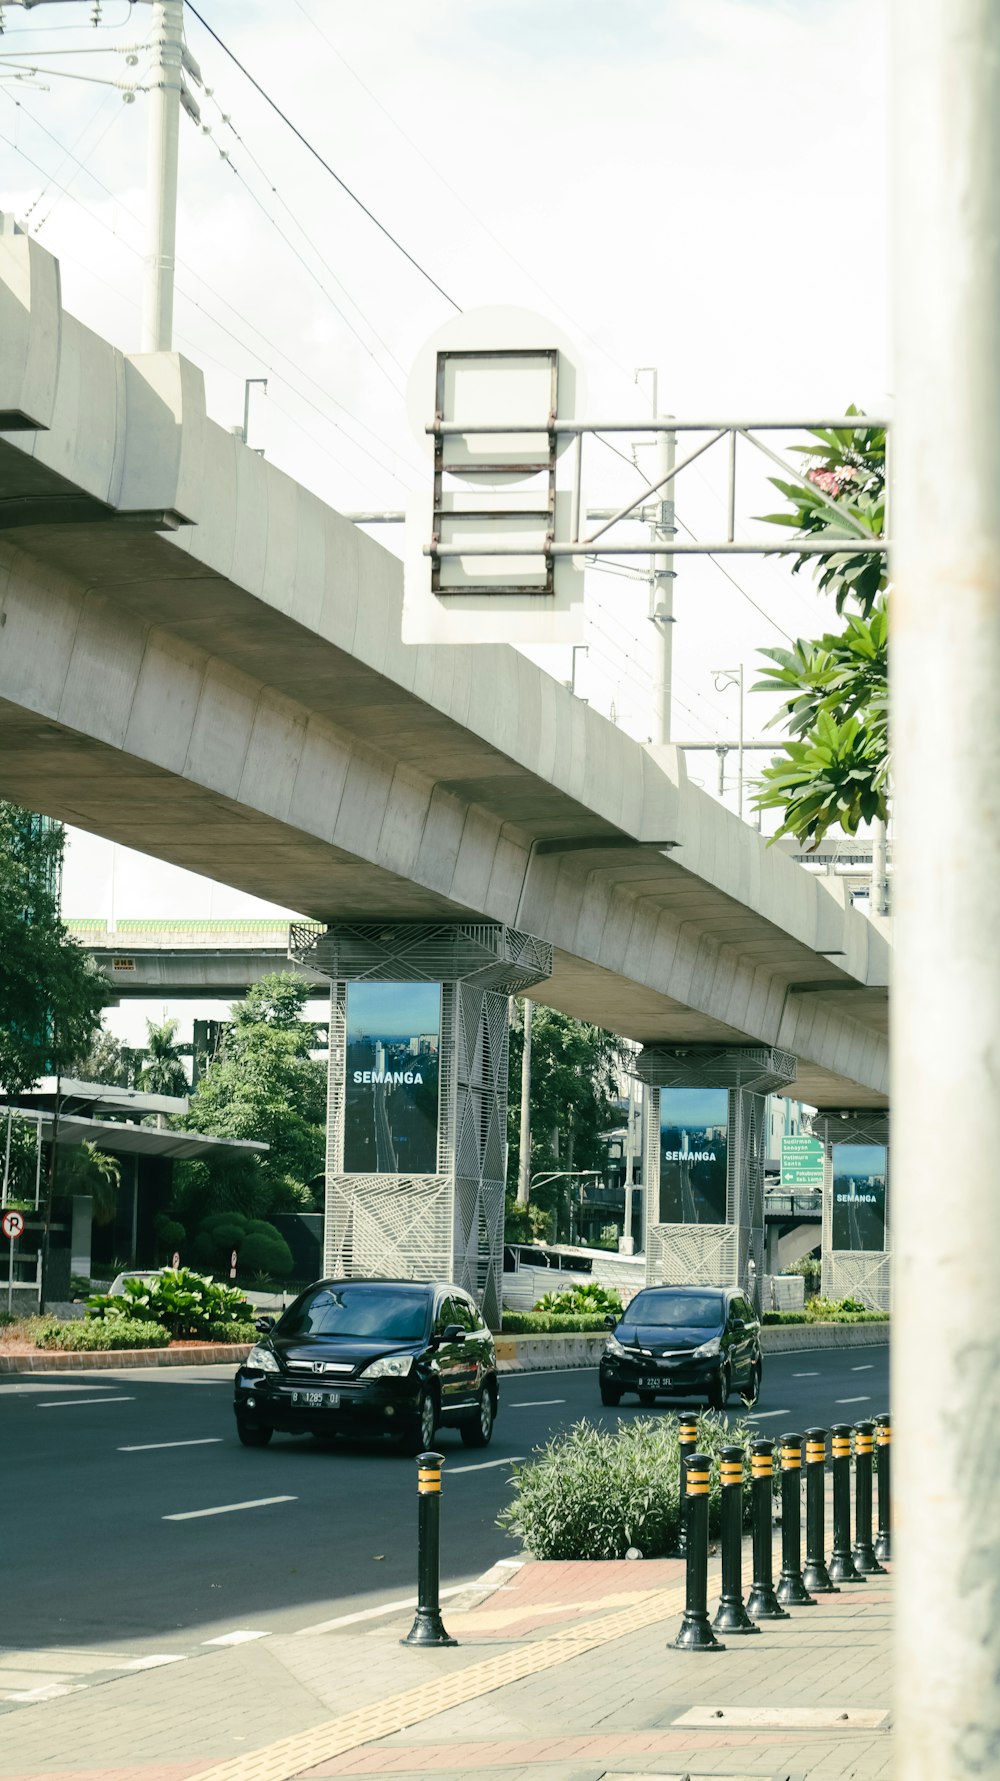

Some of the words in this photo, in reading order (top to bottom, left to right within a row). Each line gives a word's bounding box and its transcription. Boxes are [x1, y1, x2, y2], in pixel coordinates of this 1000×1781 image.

[353, 1071, 423, 1084] SEMANGA
[665, 1151, 716, 1161] SEMANGA
[836, 1194, 876, 1202] SEMANGA
[10, 1217, 19, 1231] P
[292, 1392, 298, 1402] B
[306, 1392, 323, 1402] 1285
